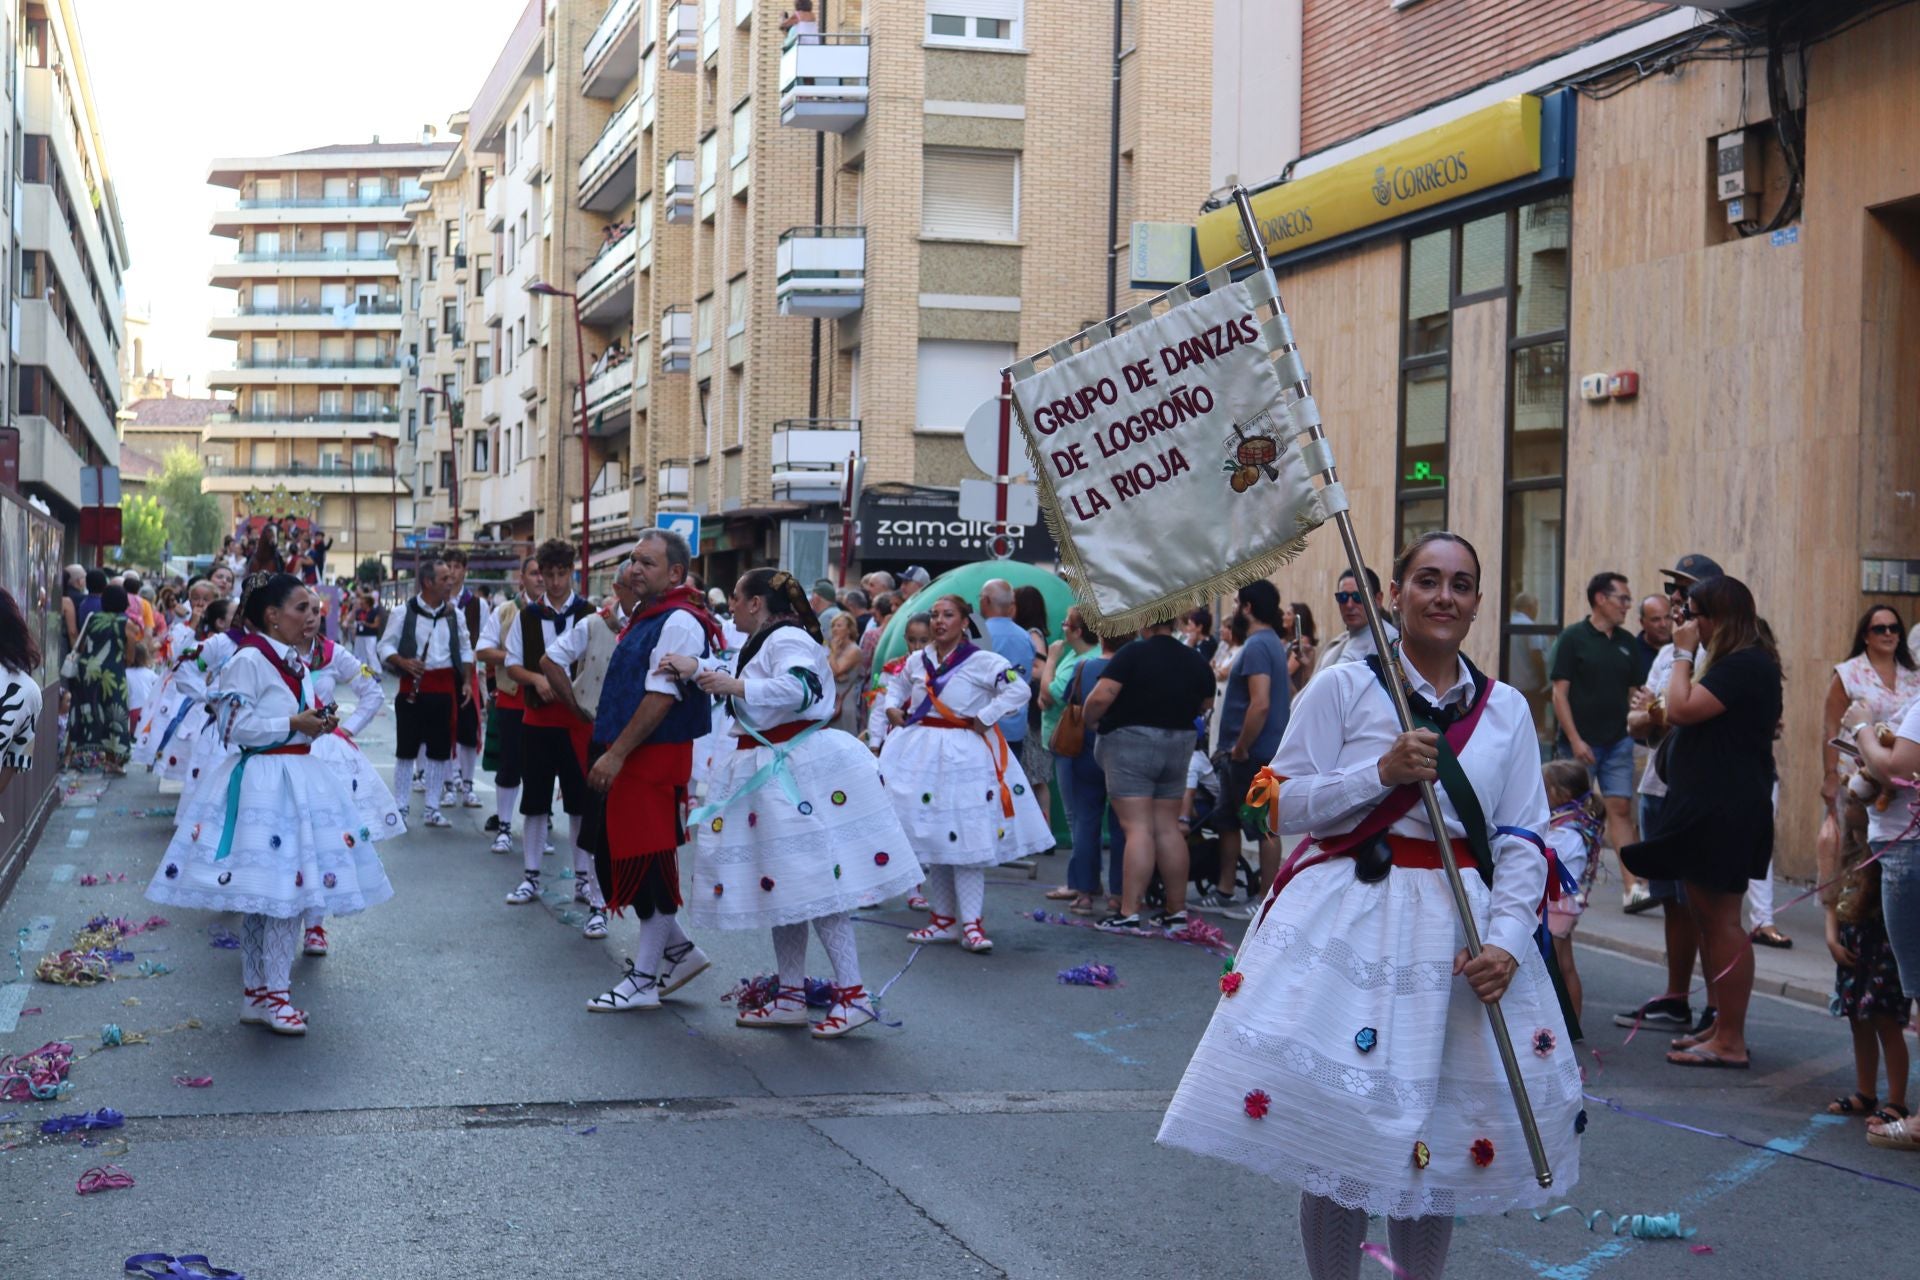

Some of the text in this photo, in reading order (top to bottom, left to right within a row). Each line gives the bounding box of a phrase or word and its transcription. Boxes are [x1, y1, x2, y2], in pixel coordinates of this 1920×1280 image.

[1394, 151, 1467, 200] CORREOS
[1258, 206, 1312, 246] ORREOS
[1034, 315, 1259, 436] GRUPO DE DANZAS
[1051, 385, 1214, 478] DE LOGROÑO
[1071, 448, 1190, 521] LA RIOJA
